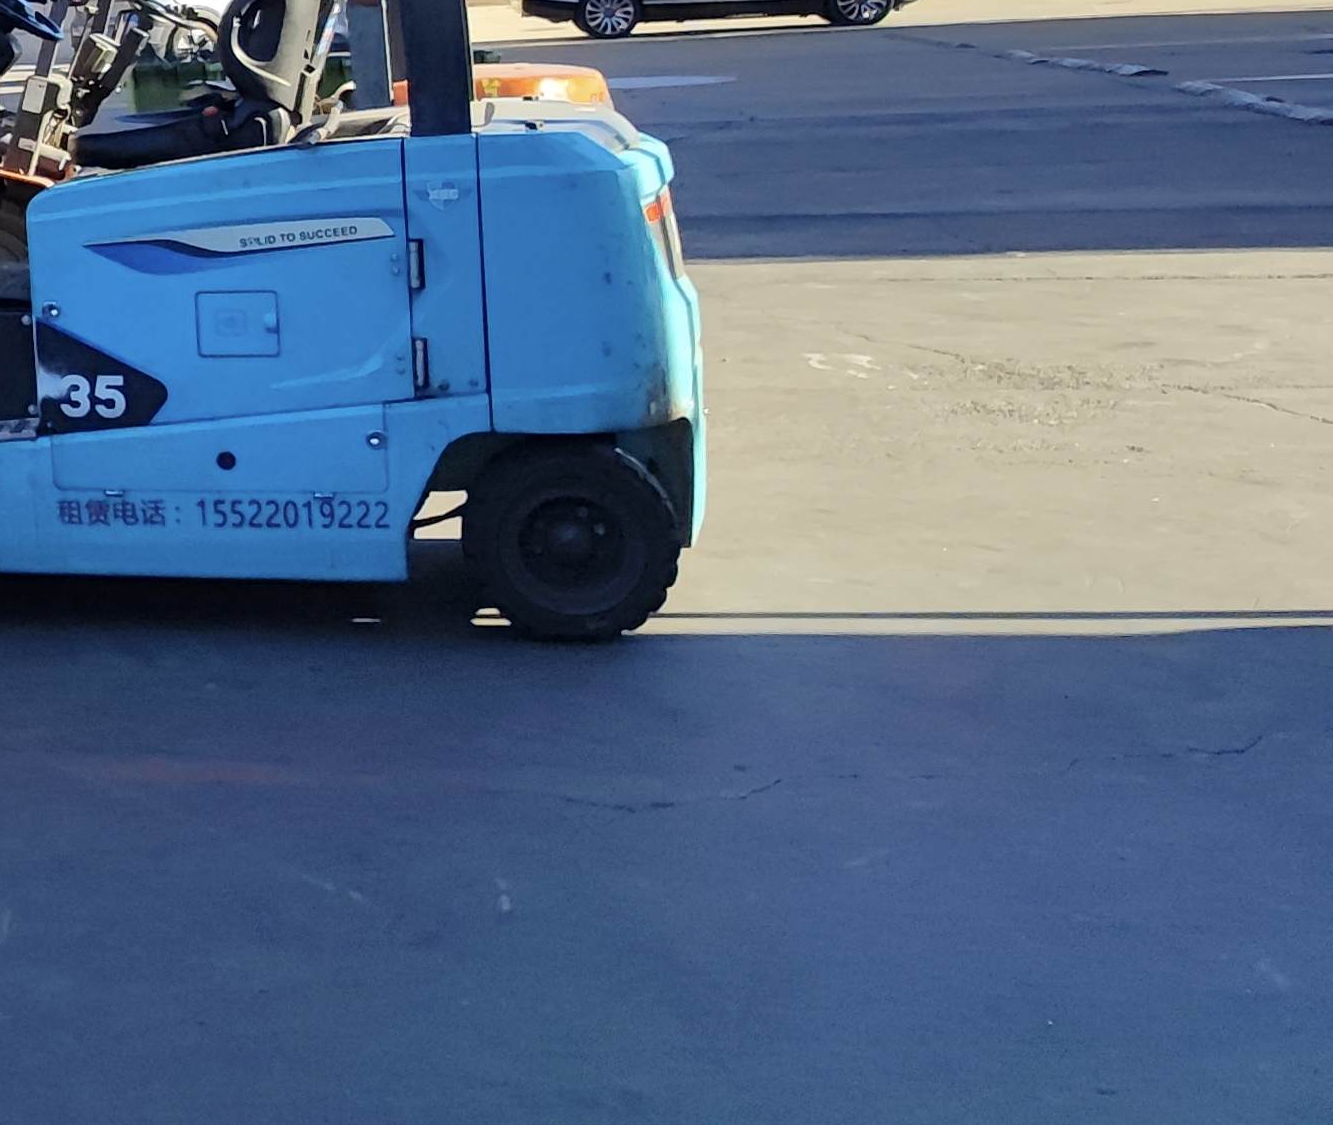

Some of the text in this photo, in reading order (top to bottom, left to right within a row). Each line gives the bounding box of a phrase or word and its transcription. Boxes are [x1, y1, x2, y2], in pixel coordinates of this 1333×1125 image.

[280, 232, 295, 243] TO
[299, 225, 358, 242] SUCCEED
[59, 374, 126, 419] 35
[196, 498, 390, 530] 15522019222
